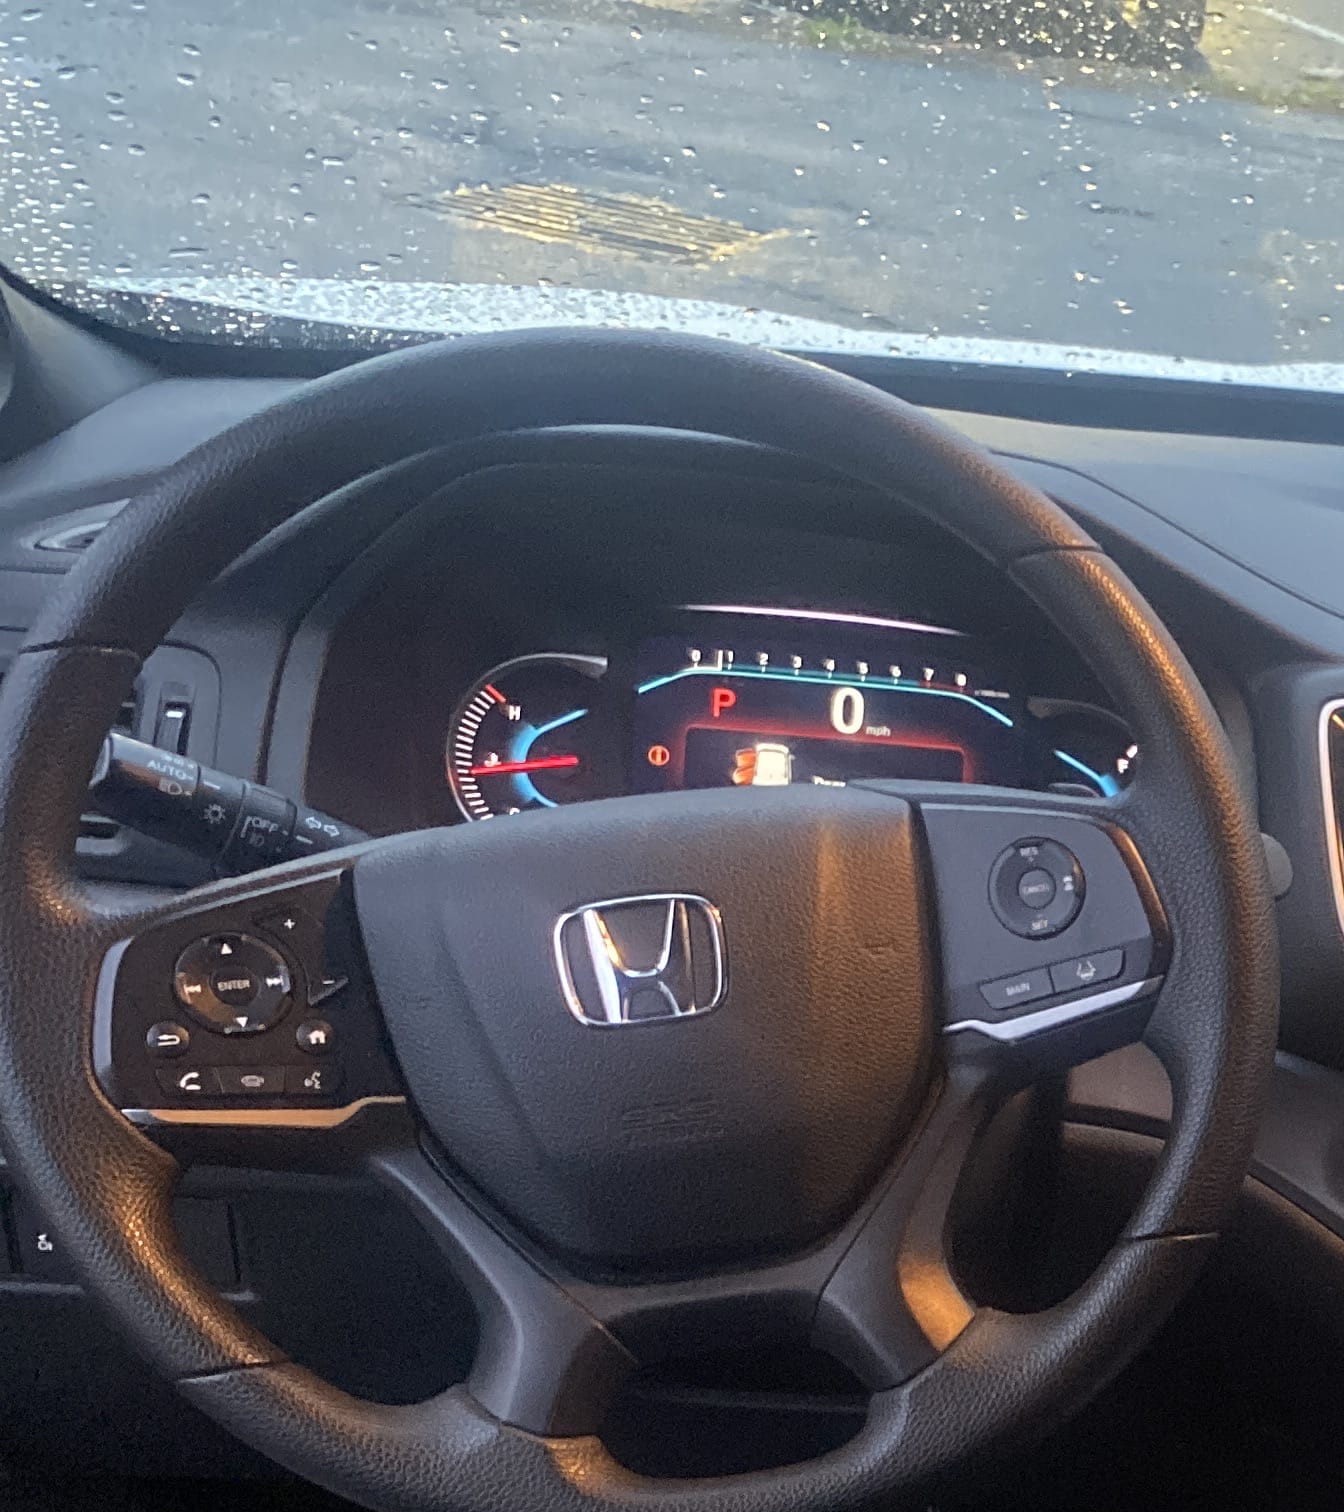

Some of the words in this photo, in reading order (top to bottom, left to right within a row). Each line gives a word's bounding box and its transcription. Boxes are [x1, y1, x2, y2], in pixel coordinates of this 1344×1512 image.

[508, 705, 521, 720] H
[710, 688, 736, 717] P
[831, 687, 865, 734] 0
[865, 726, 891, 737] mph
[147, 759, 187, 780] AUTO
[217, 979, 250, 991] ENTER
[1006, 983, 1030, 996] MAIN
